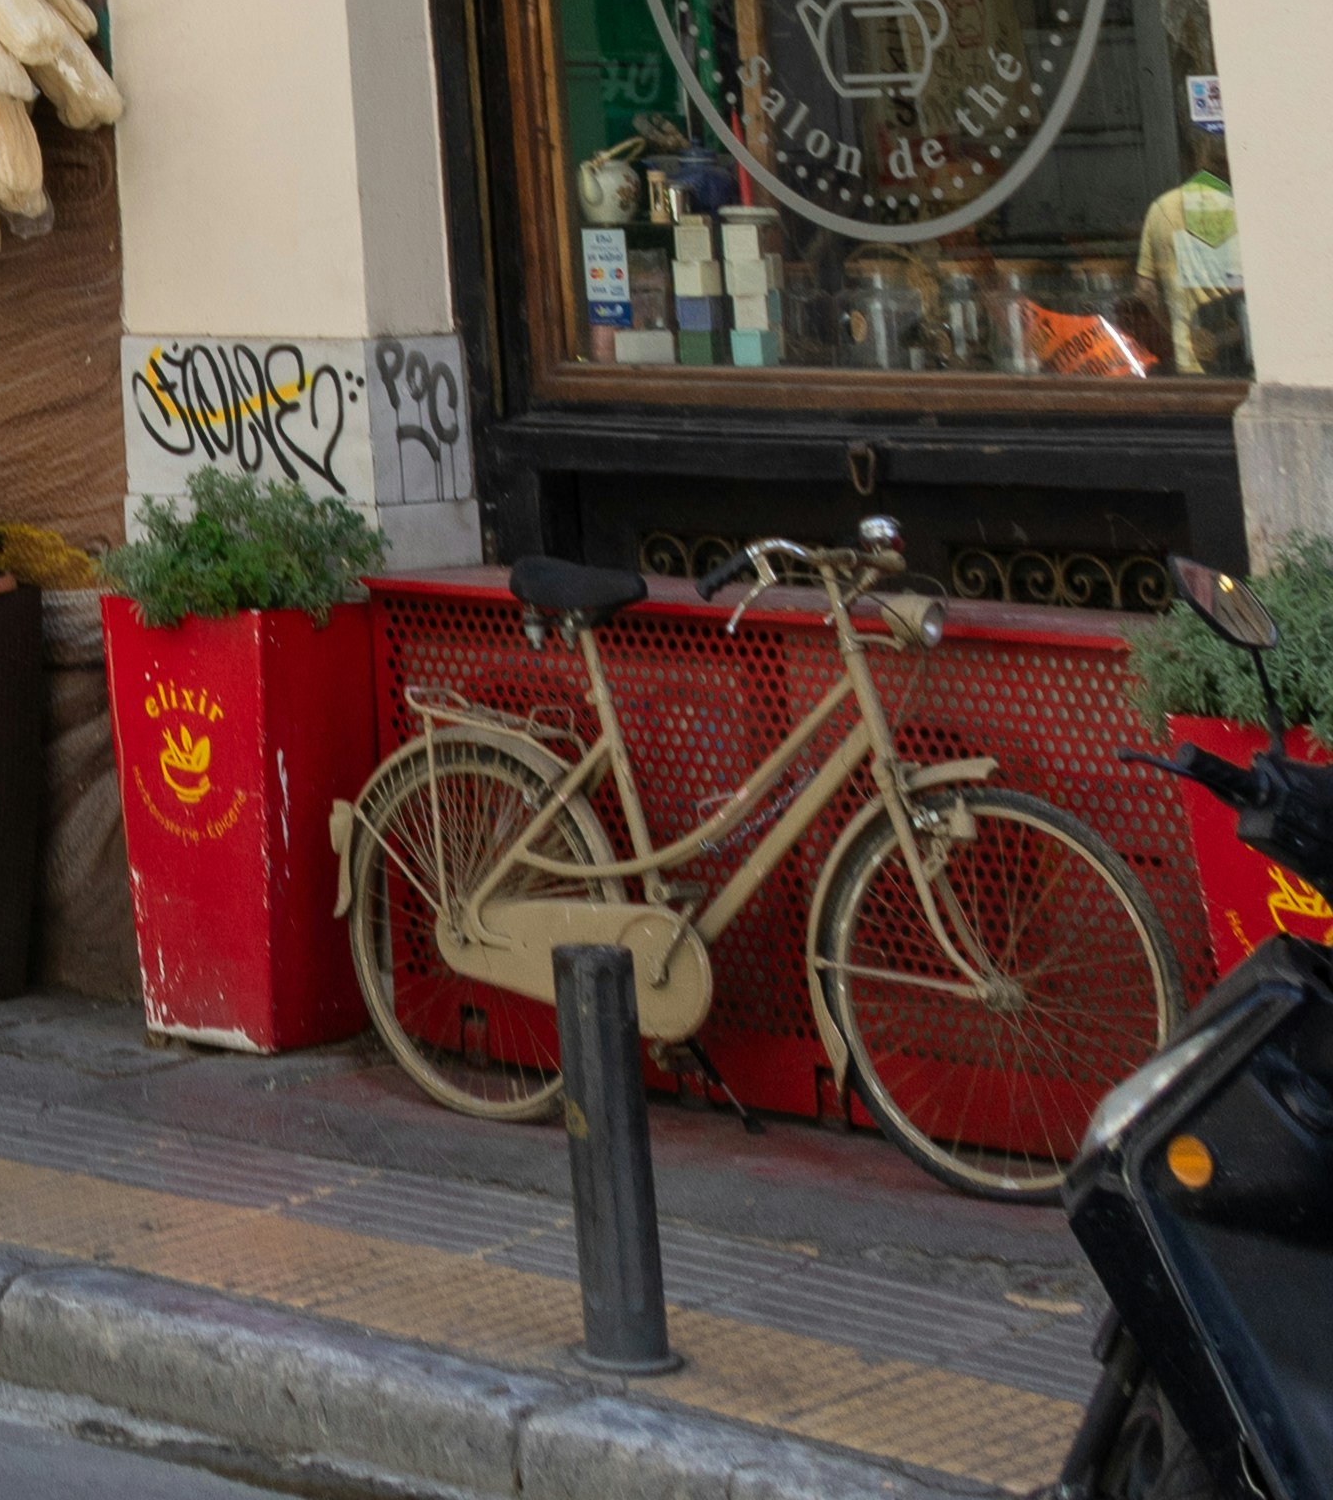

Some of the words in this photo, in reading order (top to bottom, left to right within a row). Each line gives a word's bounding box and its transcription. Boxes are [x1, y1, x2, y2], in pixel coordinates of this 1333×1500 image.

[737, 55, 862, 177] Salon
[889, 136, 947, 179] de
[956, 46, 1022, 138] thé
[145, 679, 224, 723] elixir
